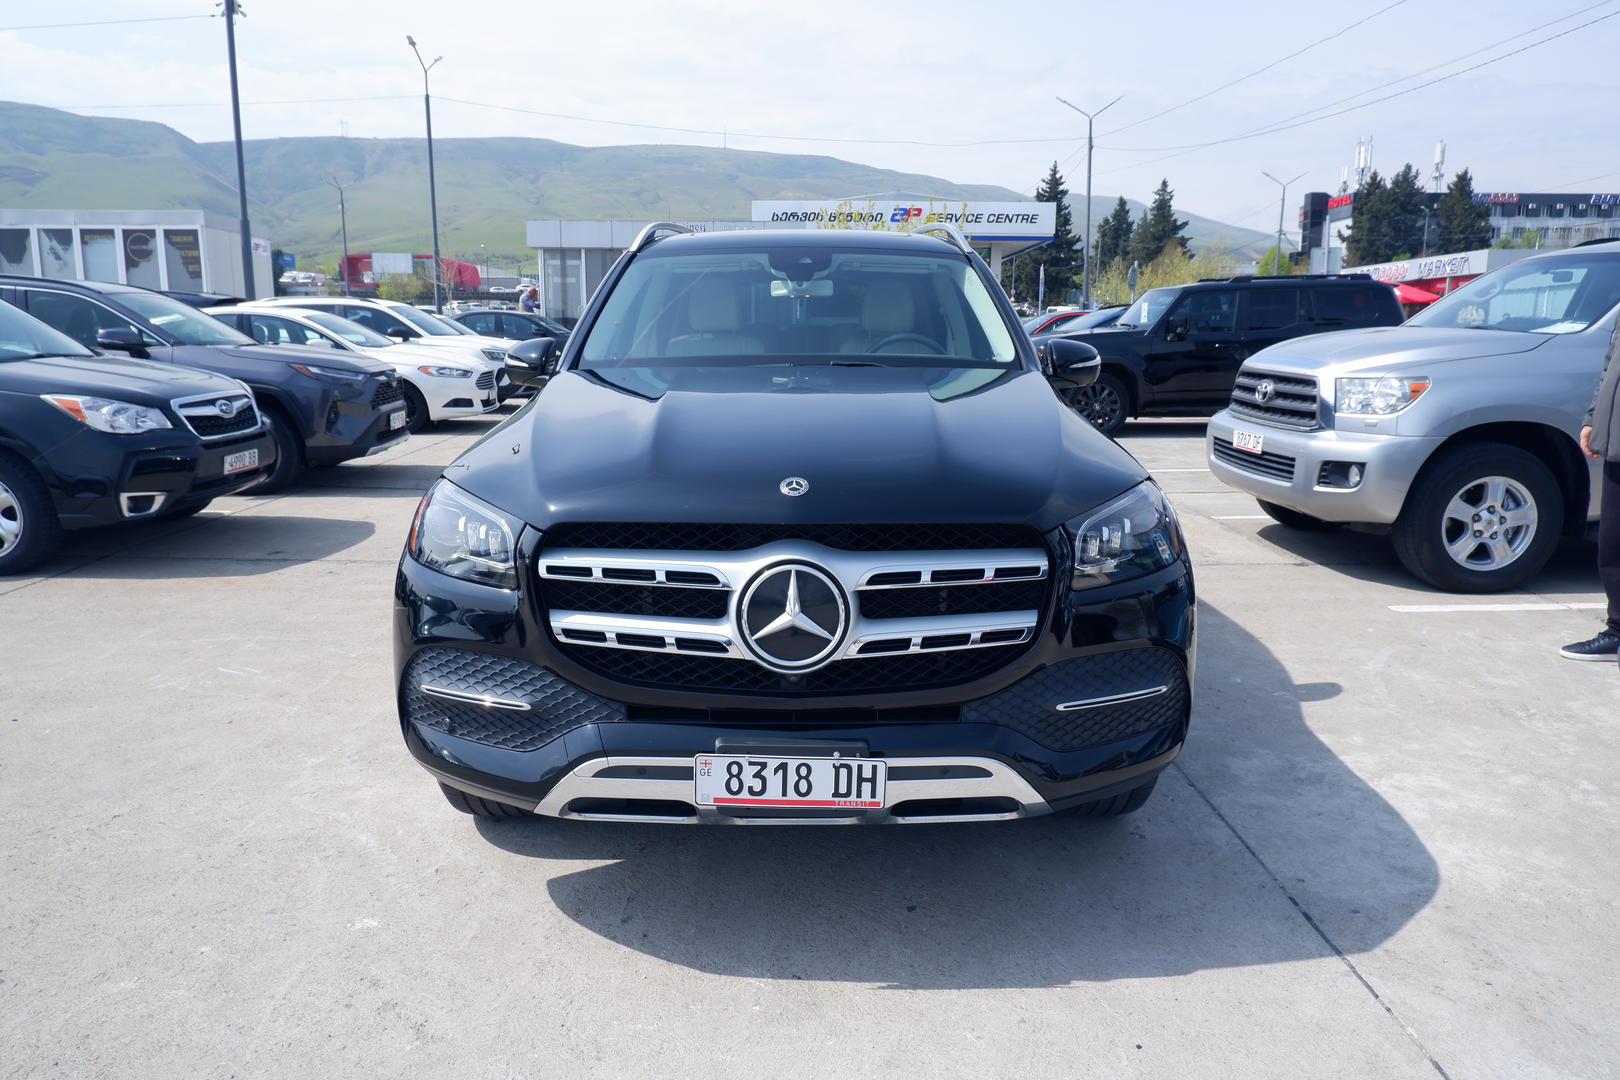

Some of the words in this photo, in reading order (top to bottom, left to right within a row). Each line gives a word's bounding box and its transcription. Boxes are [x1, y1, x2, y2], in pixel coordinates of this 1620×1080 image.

[928, 213, 983, 224] ERVICE
[987, 213, 1039, 224] CENTRE
[1417, 255, 1469, 279] MARKET
[699, 768, 712, 777] GE
[724, 760, 813, 798] 8318
[831, 762, 878, 799] DH
